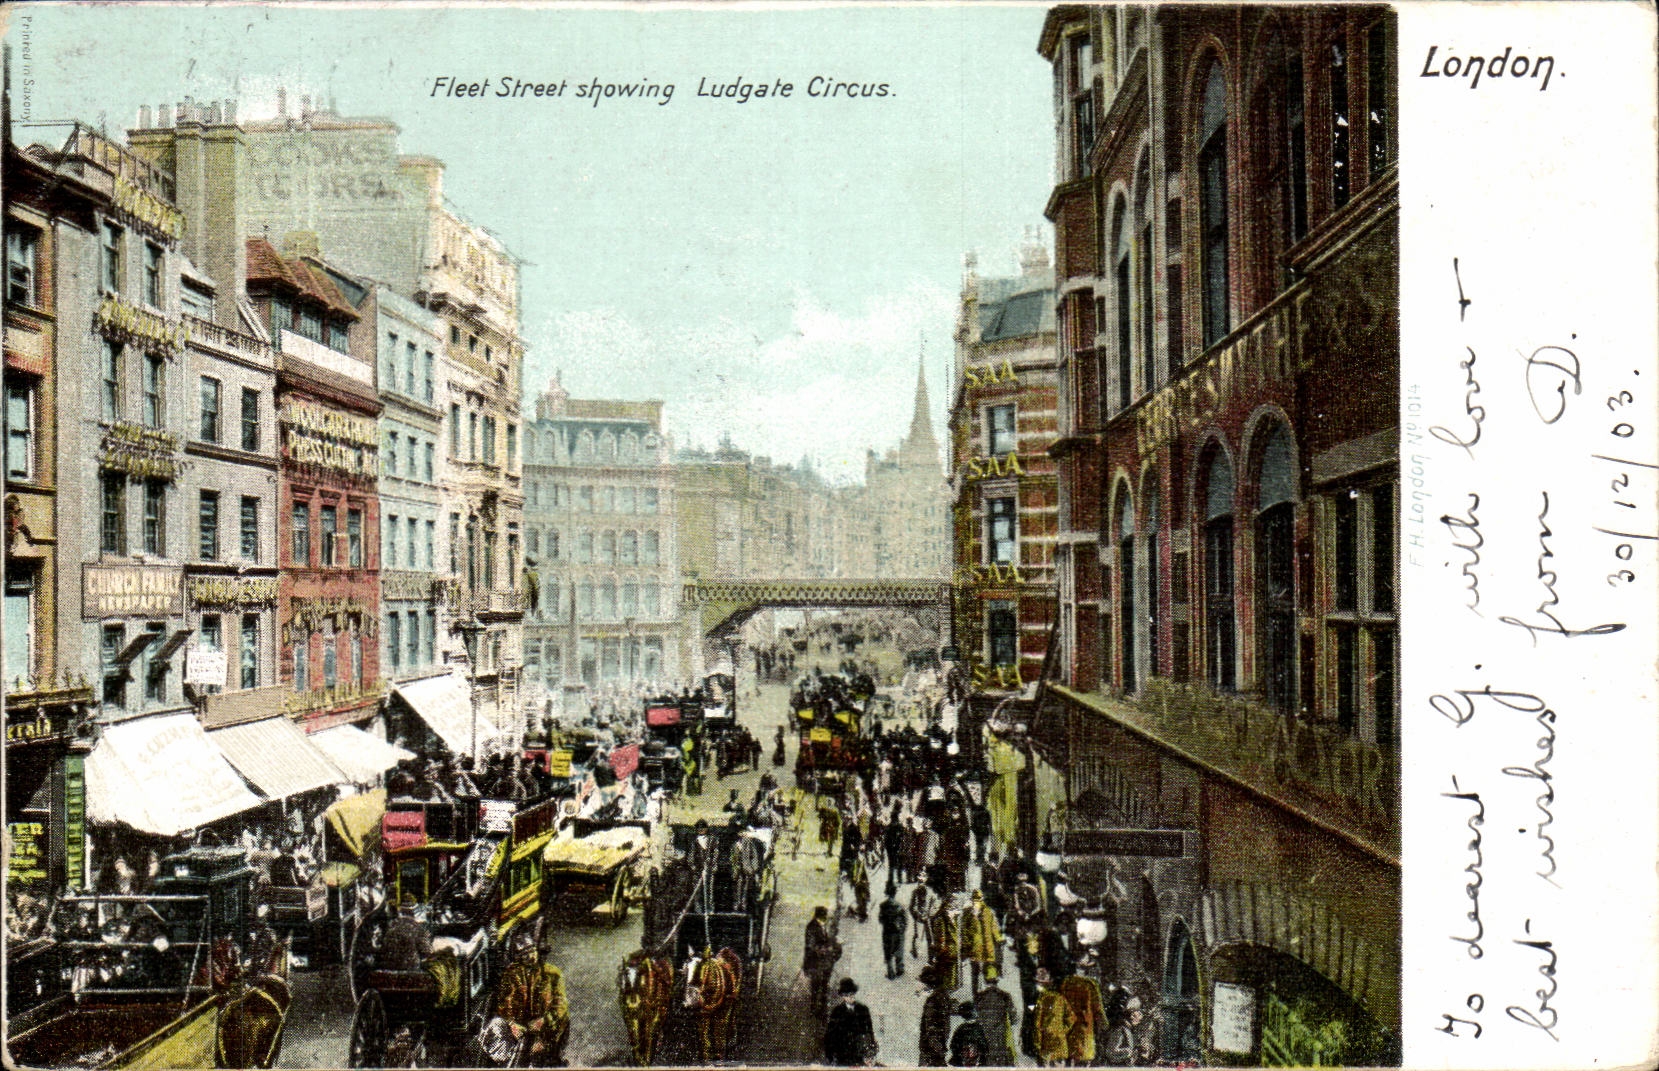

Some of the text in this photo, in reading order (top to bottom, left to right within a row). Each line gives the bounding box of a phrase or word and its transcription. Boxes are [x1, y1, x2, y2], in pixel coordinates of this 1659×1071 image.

[1428, 346, 1486, 453] love
[1439, 492, 1485, 610] with
[1498, 481, 1627, 645] from
[1501, 709, 1557, 880] wishes
[1441, 774, 1485, 960] dearest
[1434, 993, 1485, 1040] To
[1505, 918, 1559, 1042] best
